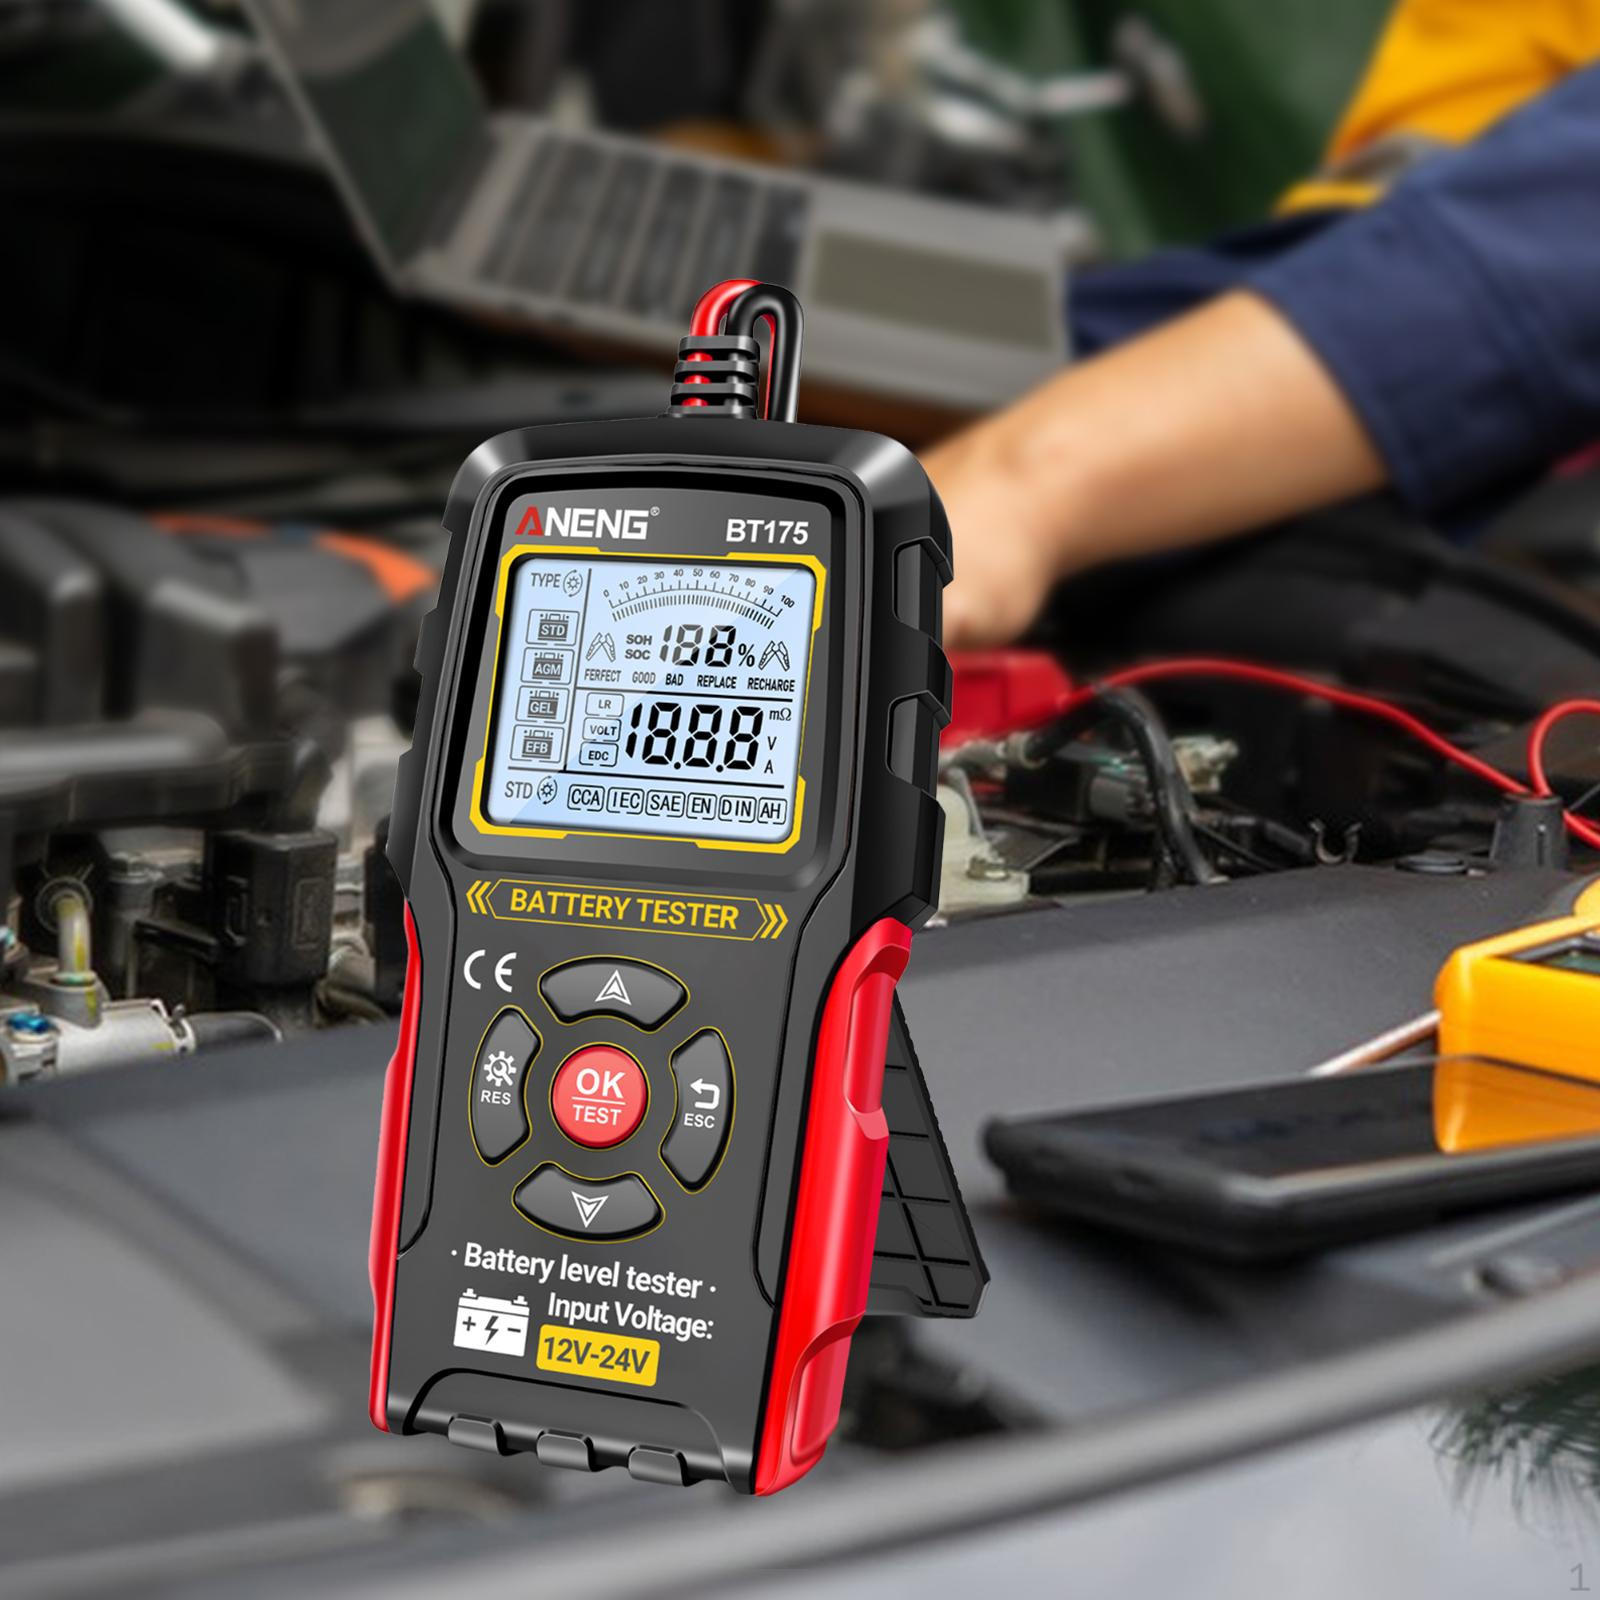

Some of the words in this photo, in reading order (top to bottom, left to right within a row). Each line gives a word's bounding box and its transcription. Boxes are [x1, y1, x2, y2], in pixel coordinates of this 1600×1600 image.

[726, 519, 809, 545] BT175
[531, 572, 561, 588] TYPE
[603, 589, 610, 598] 0
[619, 581, 630, 591] 10
[637, 575, 648, 585] 20
[654, 571, 665, 580] 30
[673, 569, 684, 577] 40
[692, 568, 703, 577] 50
[710, 570, 721, 579] 60
[729, 573, 740, 583] 70
[744, 577, 756, 588] 80
[763, 584, 775, 596] 90
[781, 594, 795, 609] 100
[541, 624, 565, 636] STD
[626, 634, 652, 645] SOH
[625, 649, 651, 660] SOC
[535, 663, 561, 676] AGM
[632, 671, 656, 684] GOOD
[665, 673, 684, 686] BAD
[697, 675, 737, 689] REPLACE
[747, 676, 796, 692] RECHARGE
[530, 701, 554, 714] GEL
[598, 699, 612, 709] LR
[590, 725, 618, 736] VOLT
[525, 741, 549, 754] EFB
[767, 736, 777, 750] V
[588, 750, 609, 761] EDC
[764, 760, 774, 774] A
[505, 781, 533, 799] STD
[571, 788, 600, 806] CCA
[612, 791, 640, 809] IEC
[650, 794, 683, 812] SAE
[691, 798, 711, 814] EN
[723, 799, 751, 817] DIN
[760, 802, 781, 819] AH
[510, 888, 631, 920] BATTERY
[636, 898, 739, 929] TESTER
[463, 949, 517, 993] CE
[576, 1068, 626, 1099] OK
[481, 1090, 512, 1105] RES
[572, 1104, 622, 1126] TEST
[684, 1113, 715, 1129] ESC
[464, 1242, 555, 1284] Battery
[560, 1254, 620, 1287] level
[627, 1266, 703, 1299] tester
[548, 1292, 610, 1325] Input
[614, 1301, 714, 1342] Voltage:
[543, 1336, 651, 1374] 12V-24V
